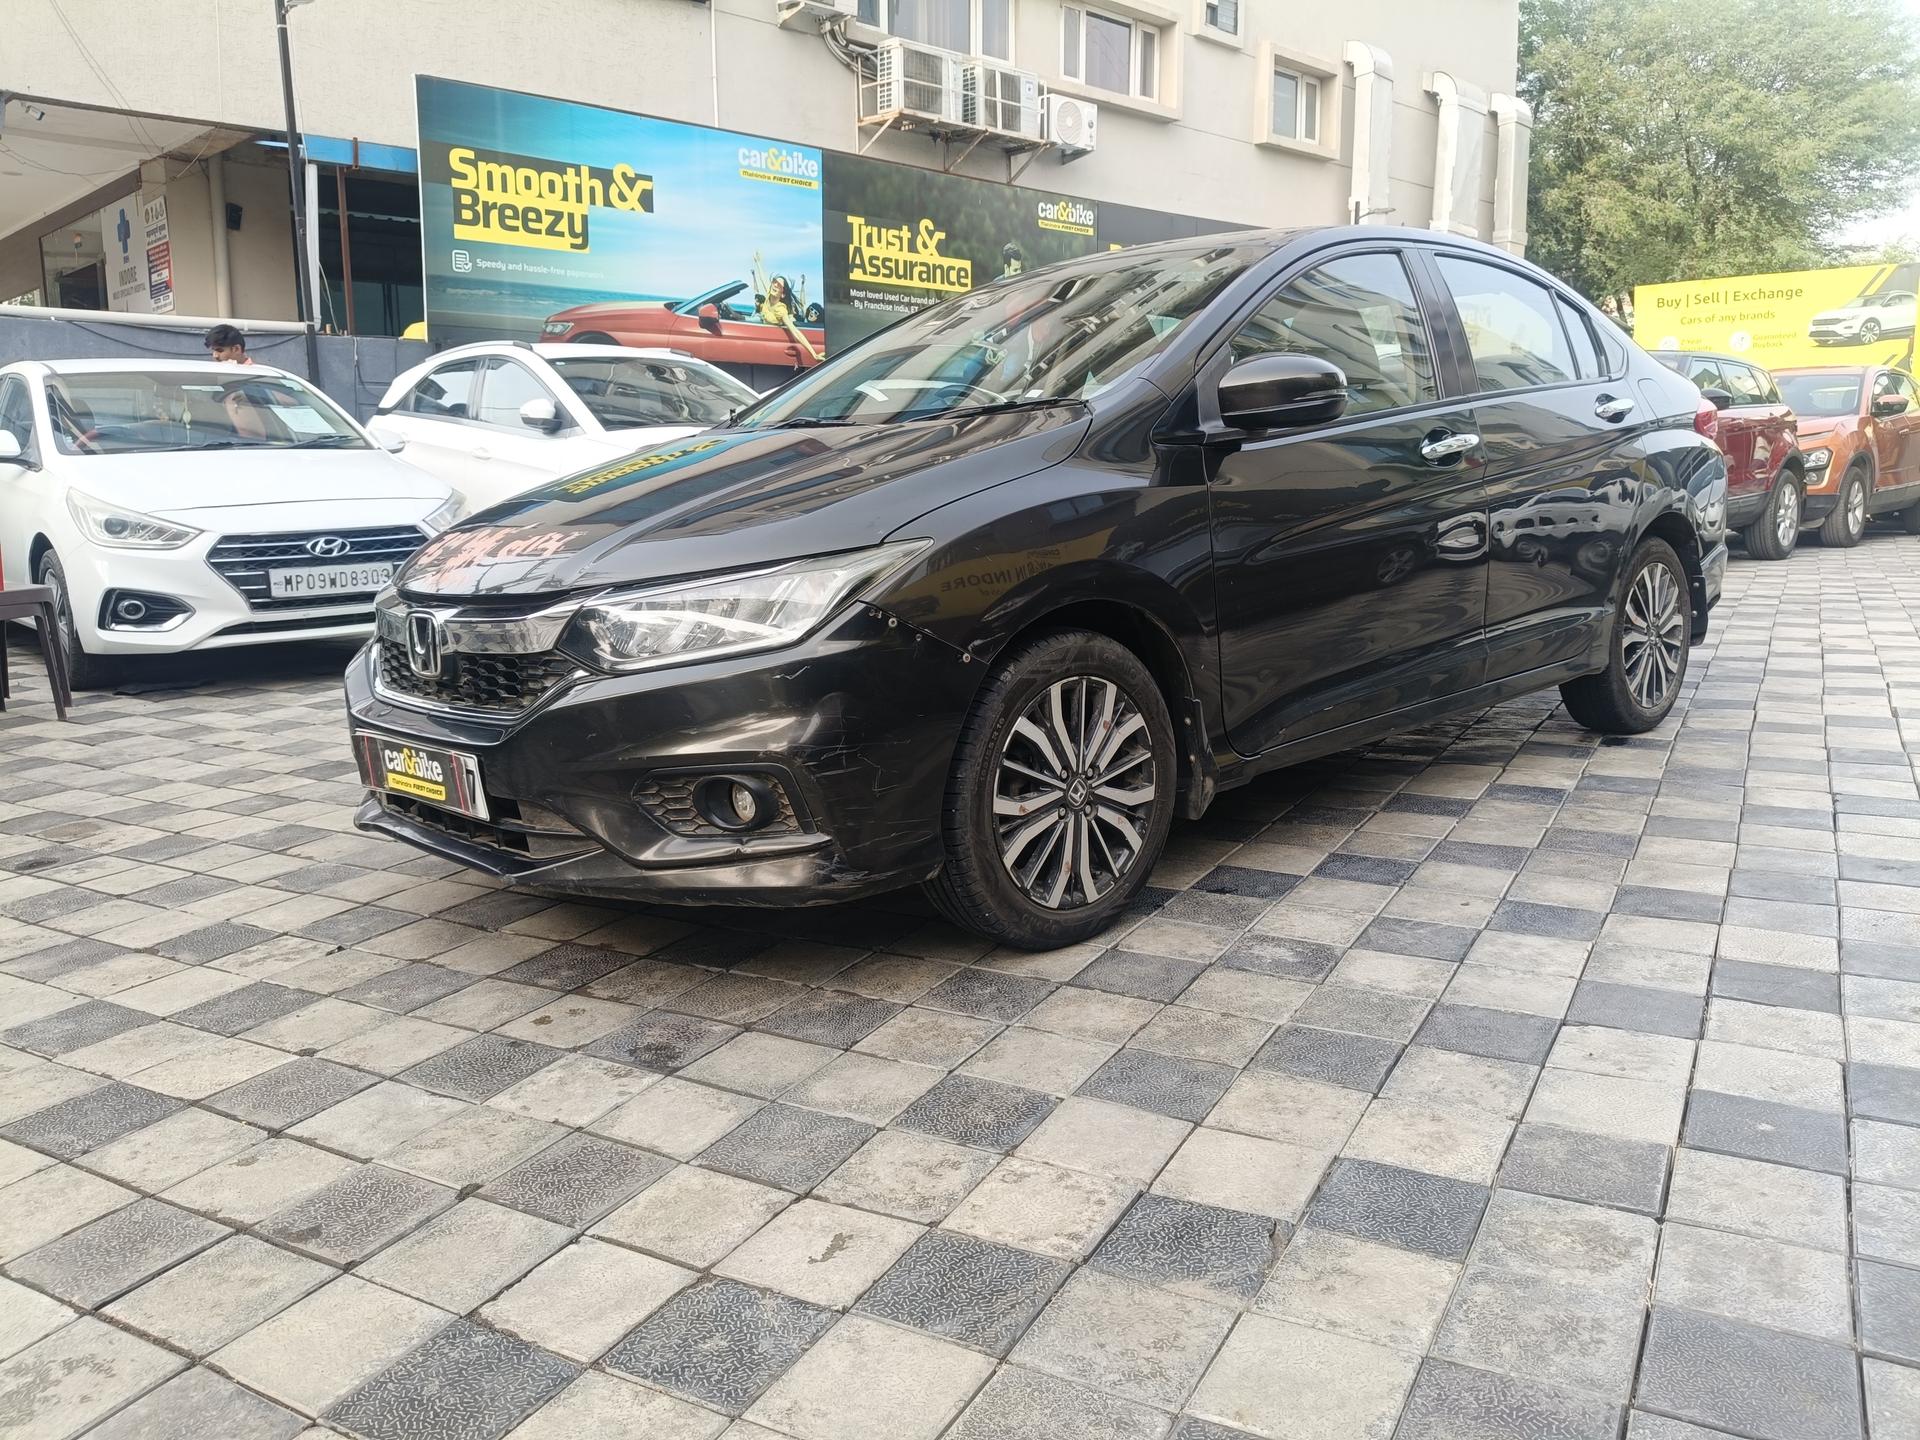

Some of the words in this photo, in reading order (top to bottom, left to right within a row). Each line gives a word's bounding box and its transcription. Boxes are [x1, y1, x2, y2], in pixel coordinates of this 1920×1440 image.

[738, 147, 818, 178] car&bike
[449, 147, 603, 207] Smooth
[609, 163, 653, 214] &
[773, 175, 790, 183] FIRST
[791, 178, 812, 187] CHOICE
[453, 188, 588, 250] Breezy
[1038, 202, 1094, 225] car&bike
[847, 215, 911, 253] Trust
[917, 218, 946, 257] &
[476, 258, 506, 271] Speedy
[507, 262, 522, 271] and
[523, 263, 565, 275] hassle-free
[849, 246, 969, 288] Assurance
[850, 288, 866, 298] Most
[866, 290, 883, 300] loved
[884, 292, 899, 302] Used
[900, 294, 910, 303] Car
[910, 295, 928, 305] brand
[854, 299, 863, 310] By
[864, 301, 893, 312] Franchise
[894, 304, 910, 314] India,
[1657, 297, 1682, 309] Buy
[1694, 292, 1720, 305] Sell
[1733, 288, 1803, 302] Exchange
[1680, 316, 1702, 325] Cars
[1705, 314, 1715, 324] of
[1718, 314, 1737, 323] any
[1739, 310, 1776, 321] brands
[284, 568, 390, 592] MP09WD8303
[384, 747, 444, 783] car&bike
[412, 782, 426, 792] FIRST
[426, 786, 443, 796] CHOICE
